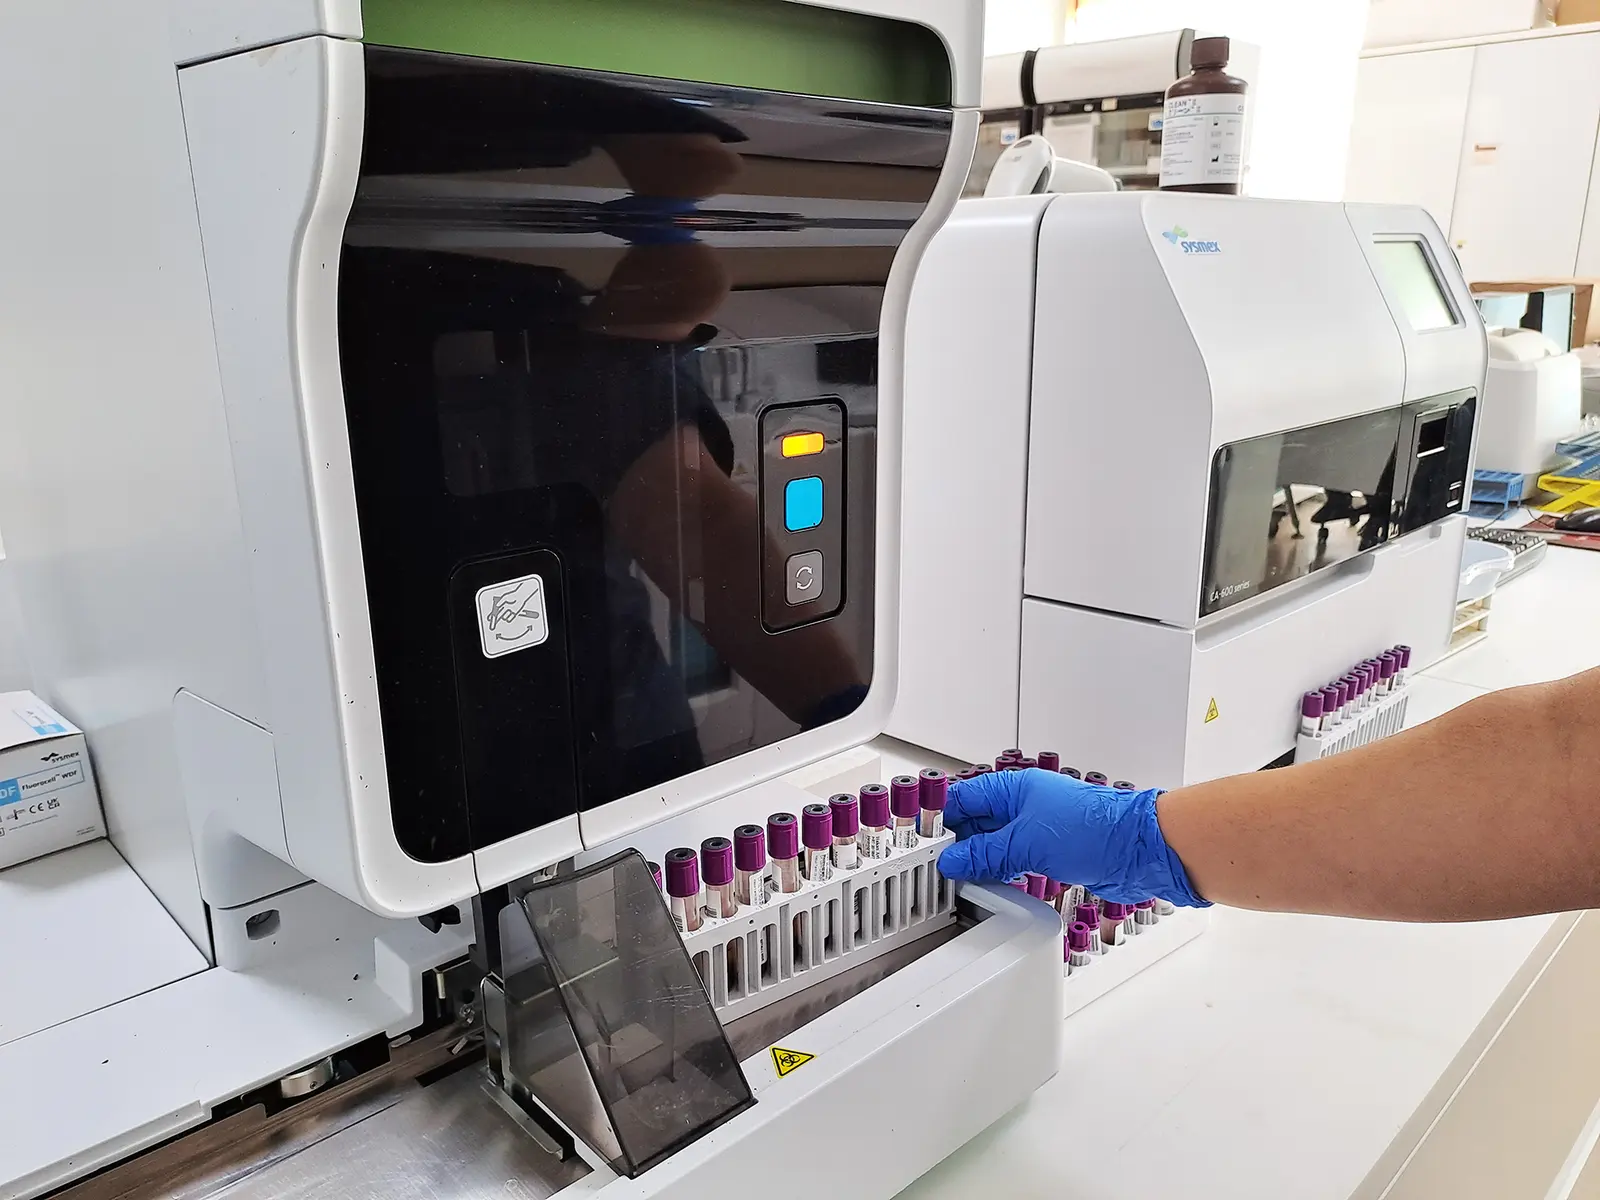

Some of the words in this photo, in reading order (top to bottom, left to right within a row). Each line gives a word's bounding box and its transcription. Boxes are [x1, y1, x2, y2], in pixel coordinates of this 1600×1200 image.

[1181, 241, 1221, 254] sysmex
[1210, 585, 1233, 601] CA-600
[1234, 580, 1250, 593] series
[51, 751, 79, 763] sysmex
[61, 770, 77, 780] WDF
